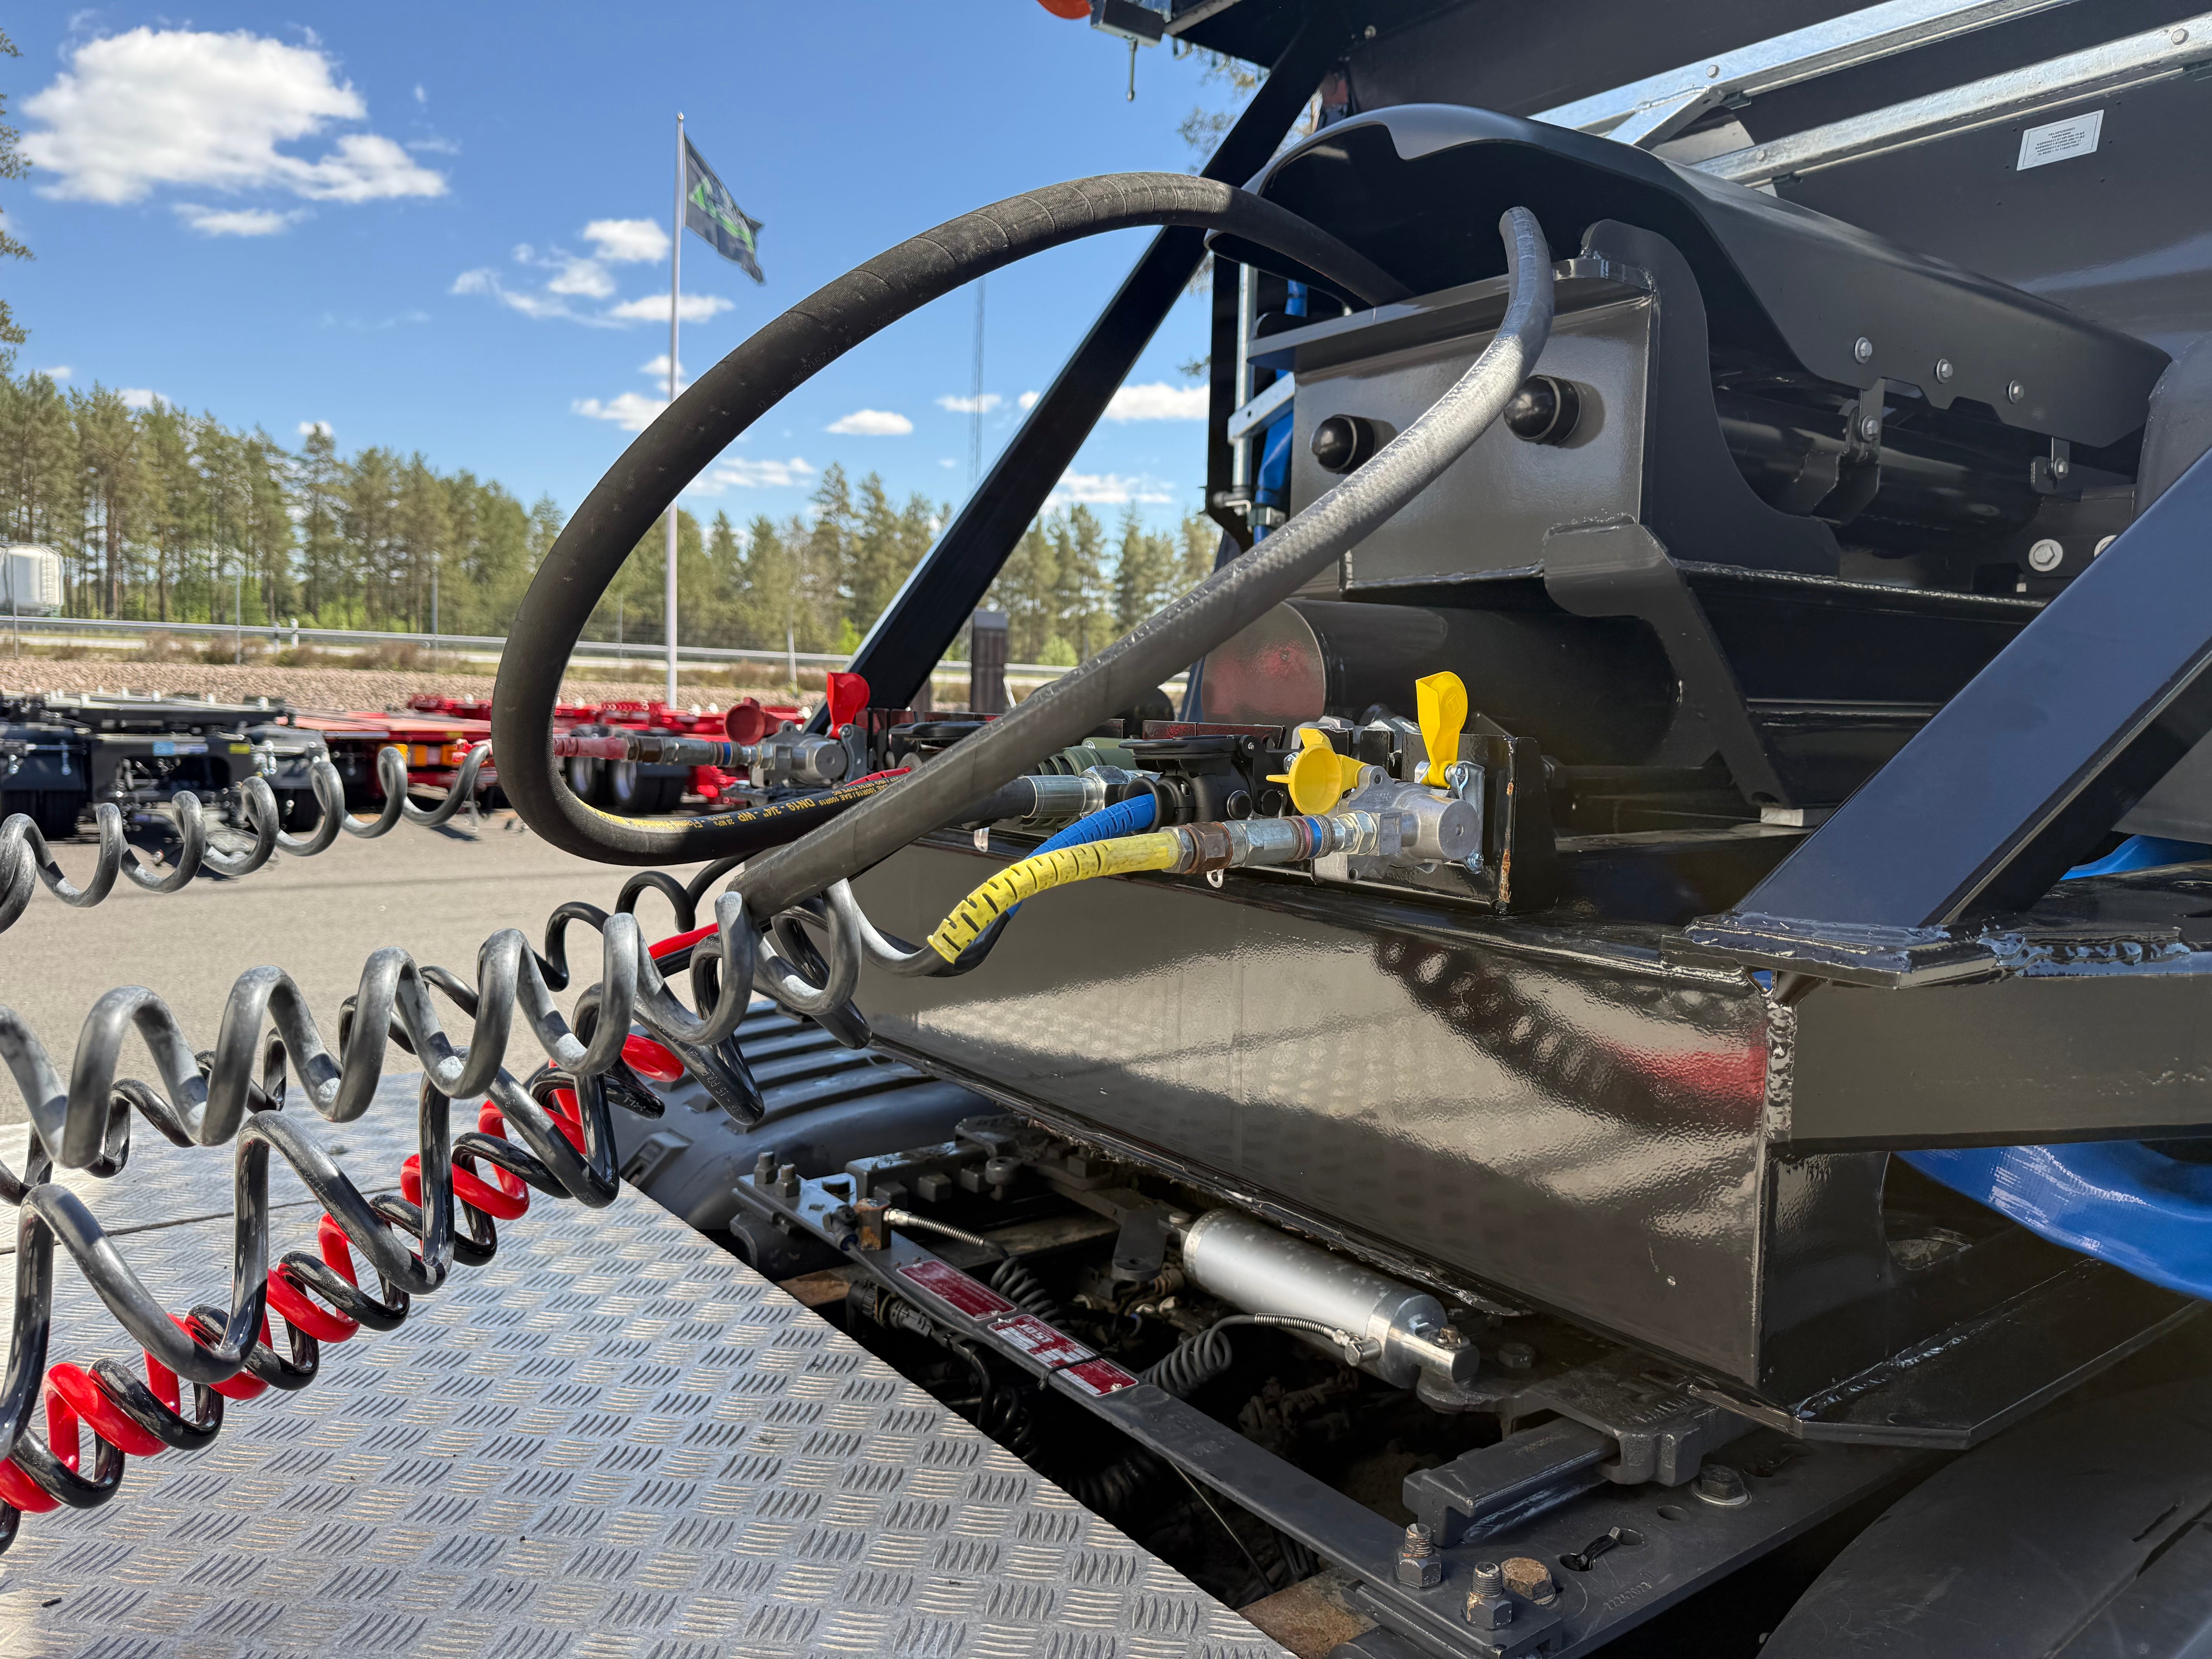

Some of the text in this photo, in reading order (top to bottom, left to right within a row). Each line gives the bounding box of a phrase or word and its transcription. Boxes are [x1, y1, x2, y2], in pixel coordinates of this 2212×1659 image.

[786, 798, 816, 811] DN19
[819, 797, 840, 805] 100R19
[737, 811, 756, 822] WP
[763, 806, 781, 817] 3/4"
[1015, 1323, 1055, 1343] JOST
